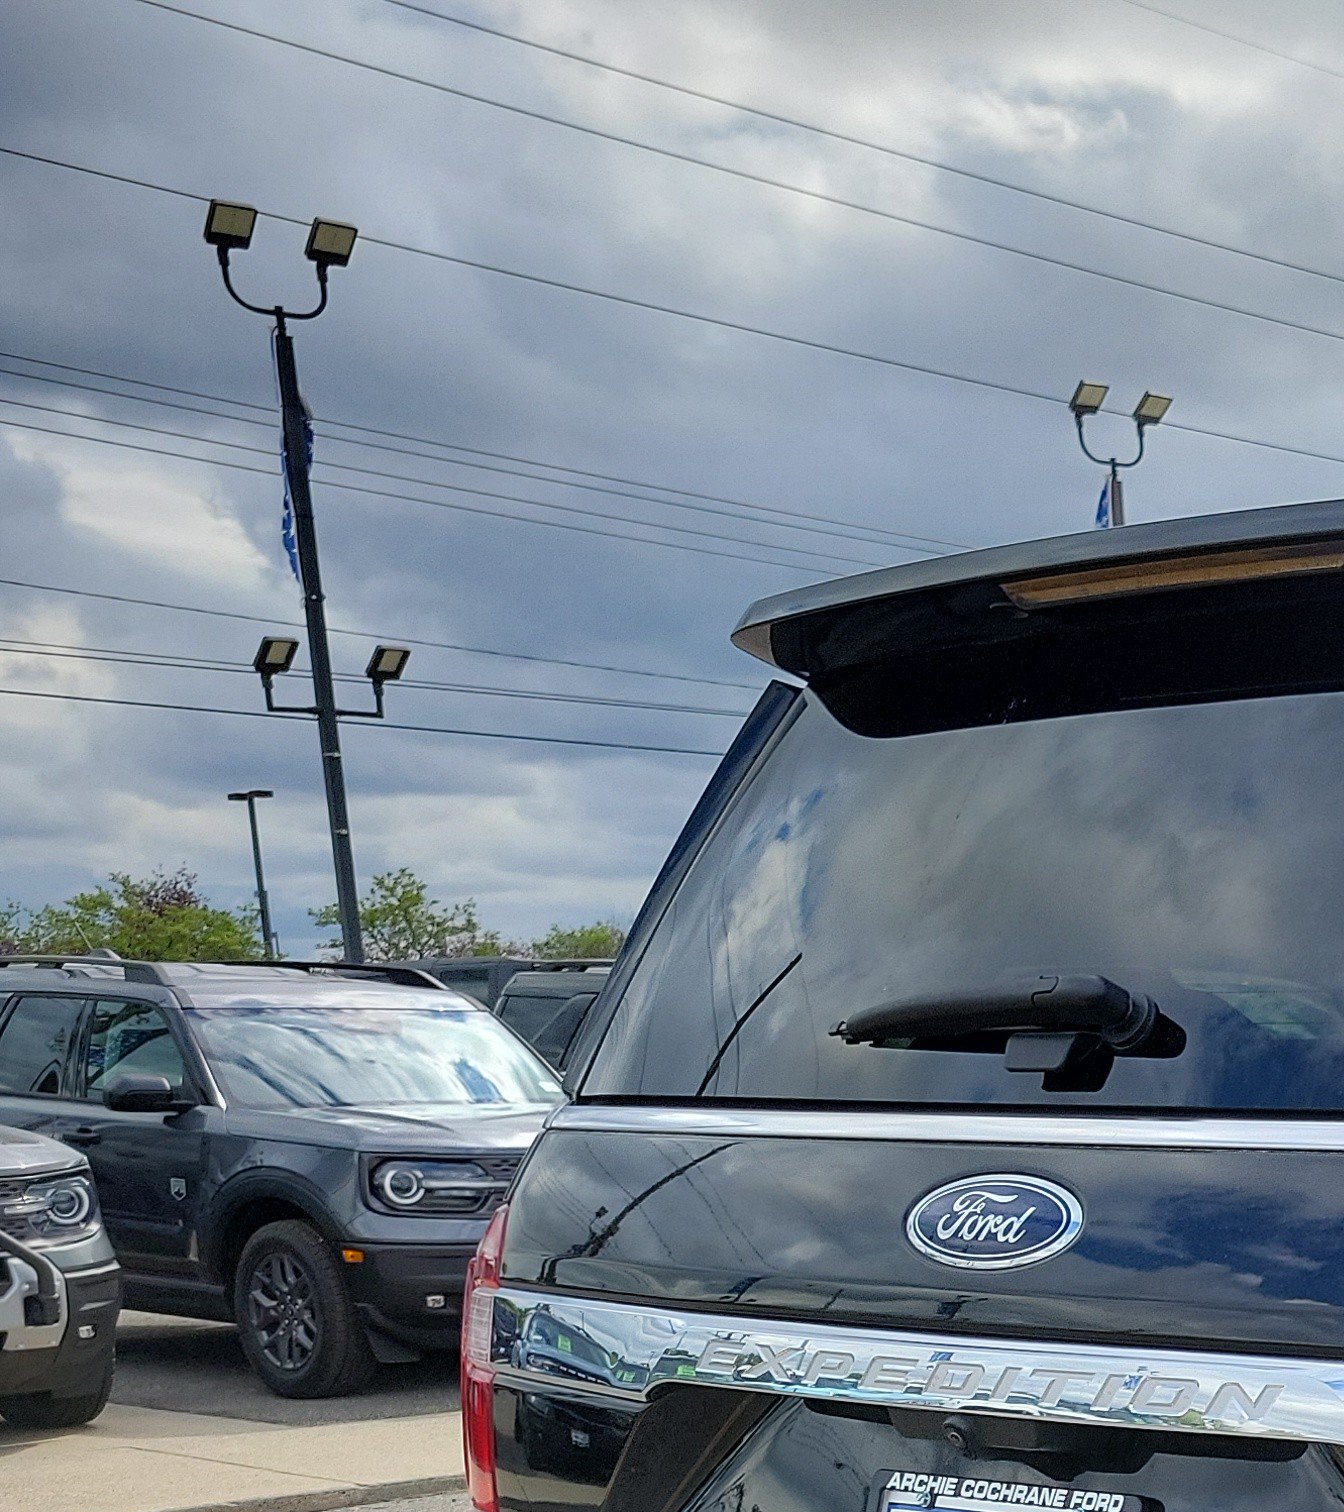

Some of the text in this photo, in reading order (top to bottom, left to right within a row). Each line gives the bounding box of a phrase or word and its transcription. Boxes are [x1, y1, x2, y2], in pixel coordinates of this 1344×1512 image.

[936, 1190, 1038, 1245] Ford
[697, 1339, 1285, 1421] EXPEDITION
[886, 1472, 958, 1497] ARCHIE
[961, 1479, 1069, 1509] COCHRANE
